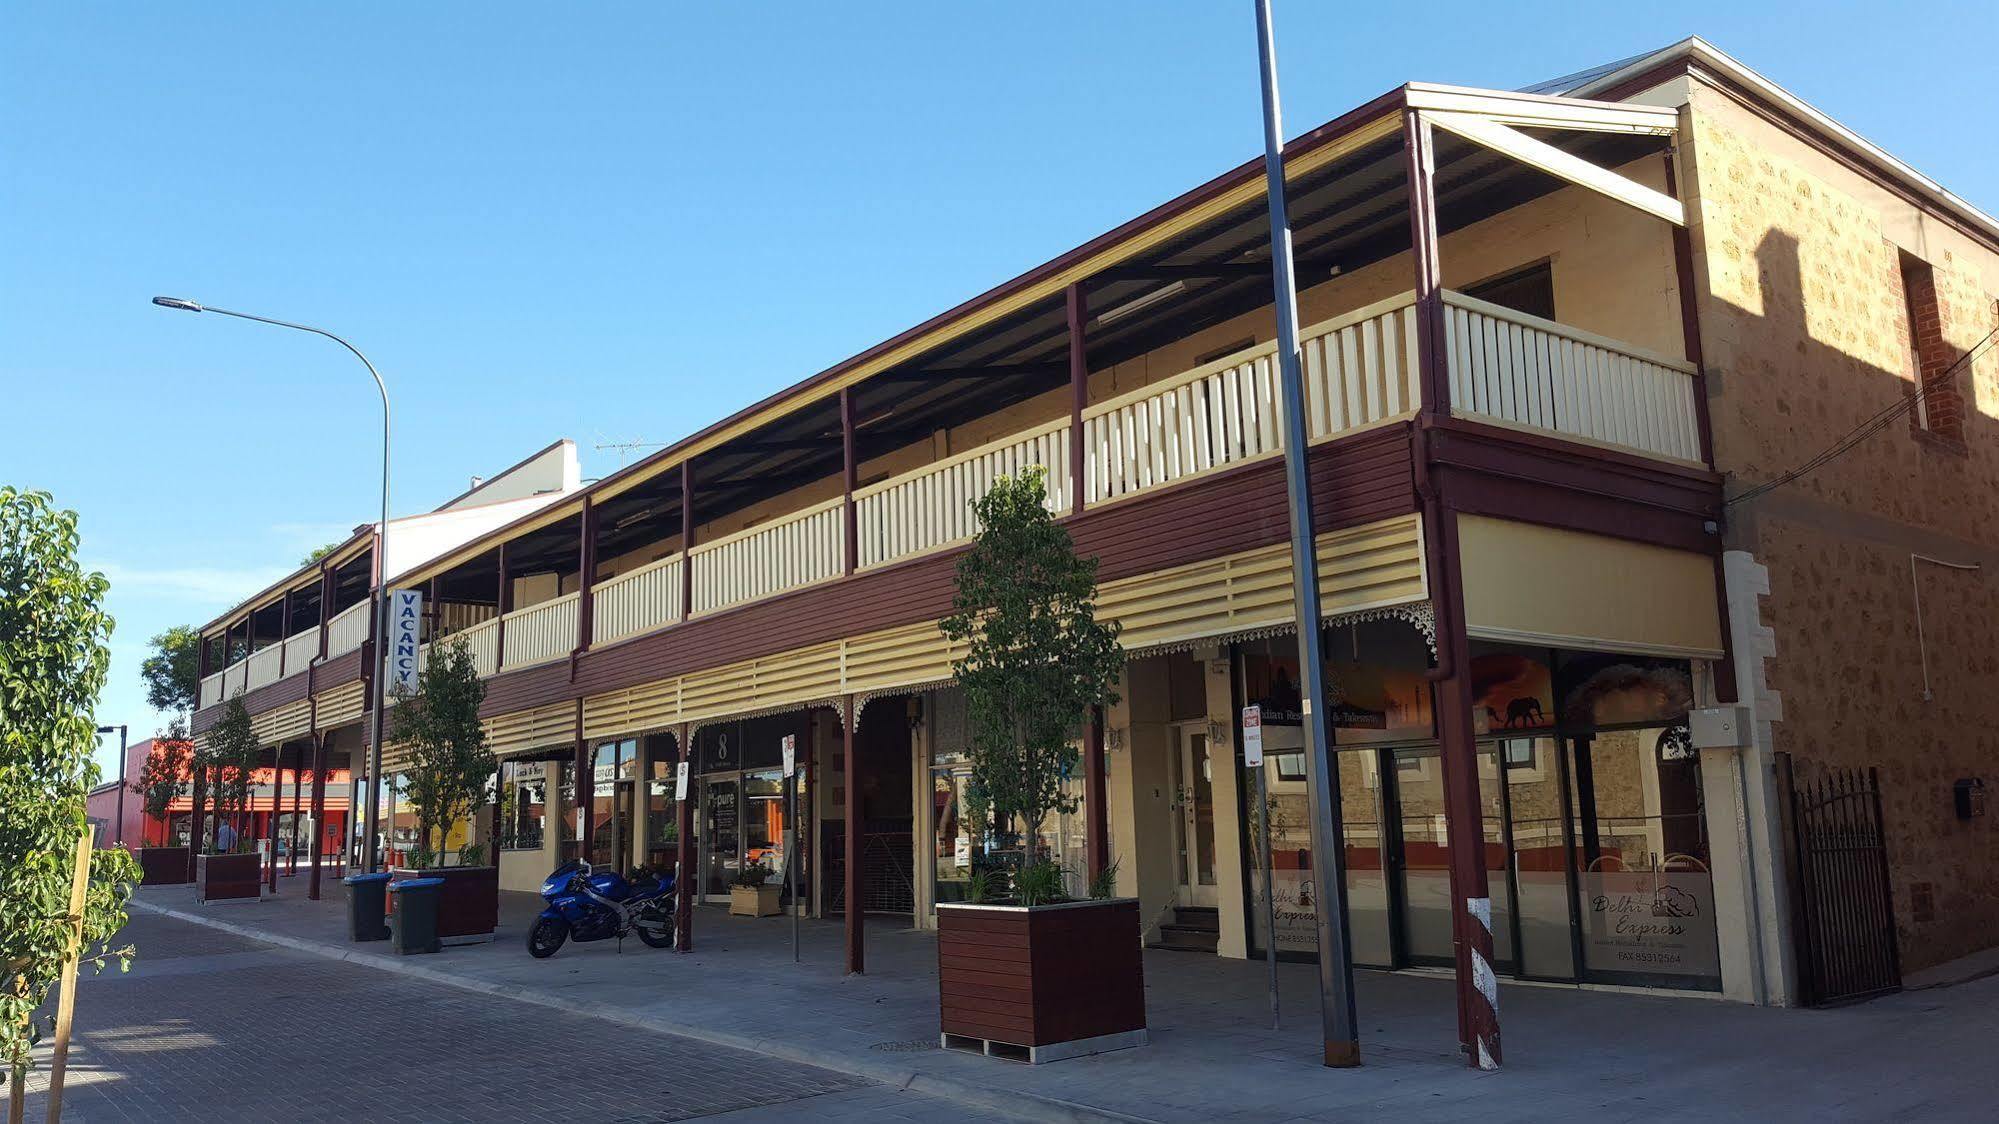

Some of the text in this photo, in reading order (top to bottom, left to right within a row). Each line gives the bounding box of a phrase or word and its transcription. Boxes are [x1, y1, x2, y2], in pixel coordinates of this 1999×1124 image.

[397, 594, 417, 682] VACANCY
[1261, 709, 1284, 720] ndian
[718, 734, 728, 760] 8
[1616, 914, 1687, 942] Express
[1618, 951, 1634, 961] FAX
